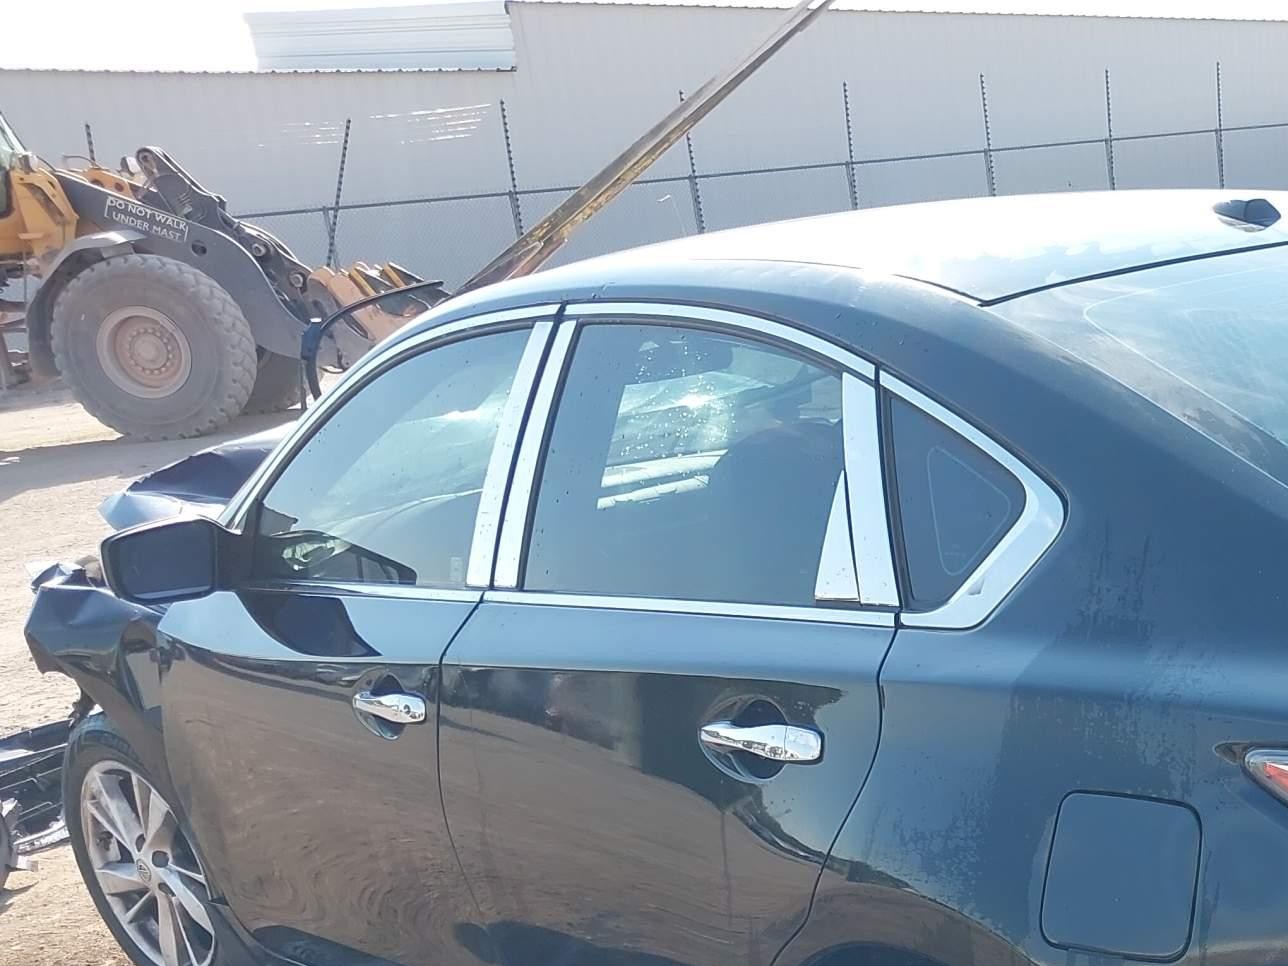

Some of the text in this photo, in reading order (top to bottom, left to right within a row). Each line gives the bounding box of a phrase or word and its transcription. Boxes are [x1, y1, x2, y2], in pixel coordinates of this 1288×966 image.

[108, 196, 186, 231] DO NOT WALK
[112, 211, 181, 241] UNDER MAST
